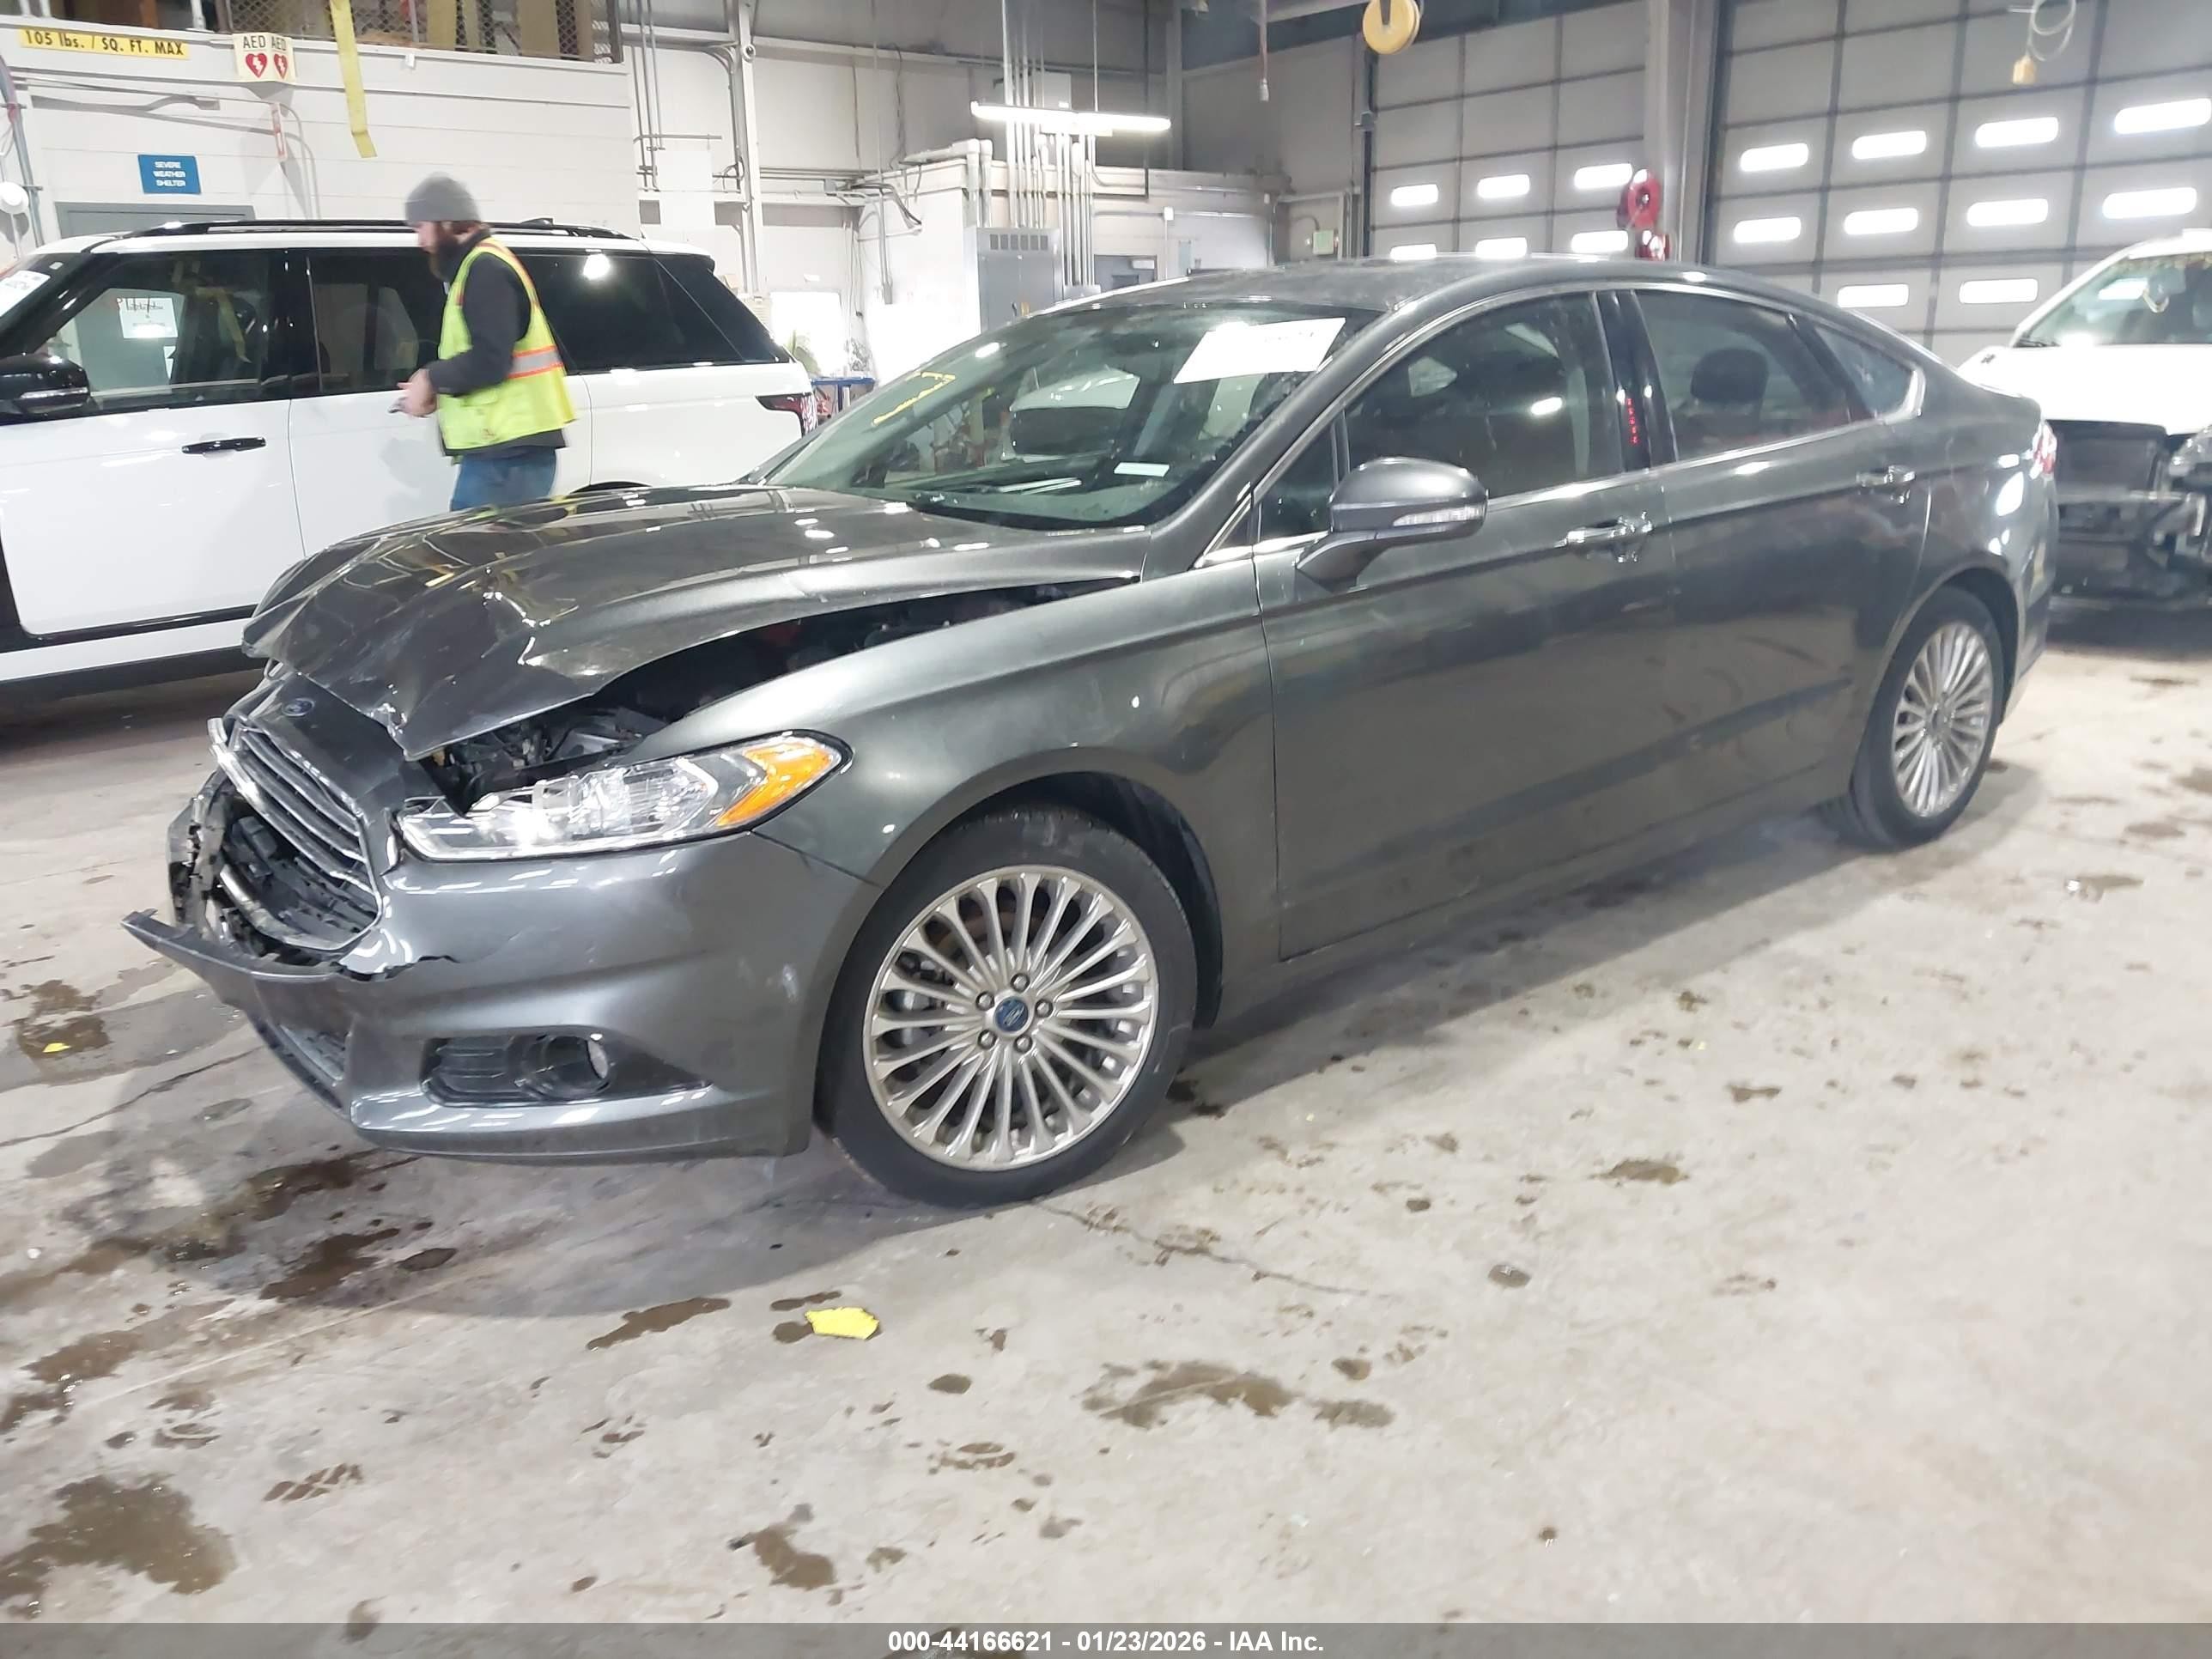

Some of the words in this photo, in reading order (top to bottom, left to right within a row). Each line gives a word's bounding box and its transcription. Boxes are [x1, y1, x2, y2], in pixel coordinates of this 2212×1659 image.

[25, 29, 53, 46] 105
[58, 32, 85, 49] lbs.
[101, 37, 125, 52] SQ.
[130, 40, 149, 53] FT.
[155, 41, 185, 56] MAX
[242, 34, 266, 49] AED
[270, 36, 287, 52] AED
